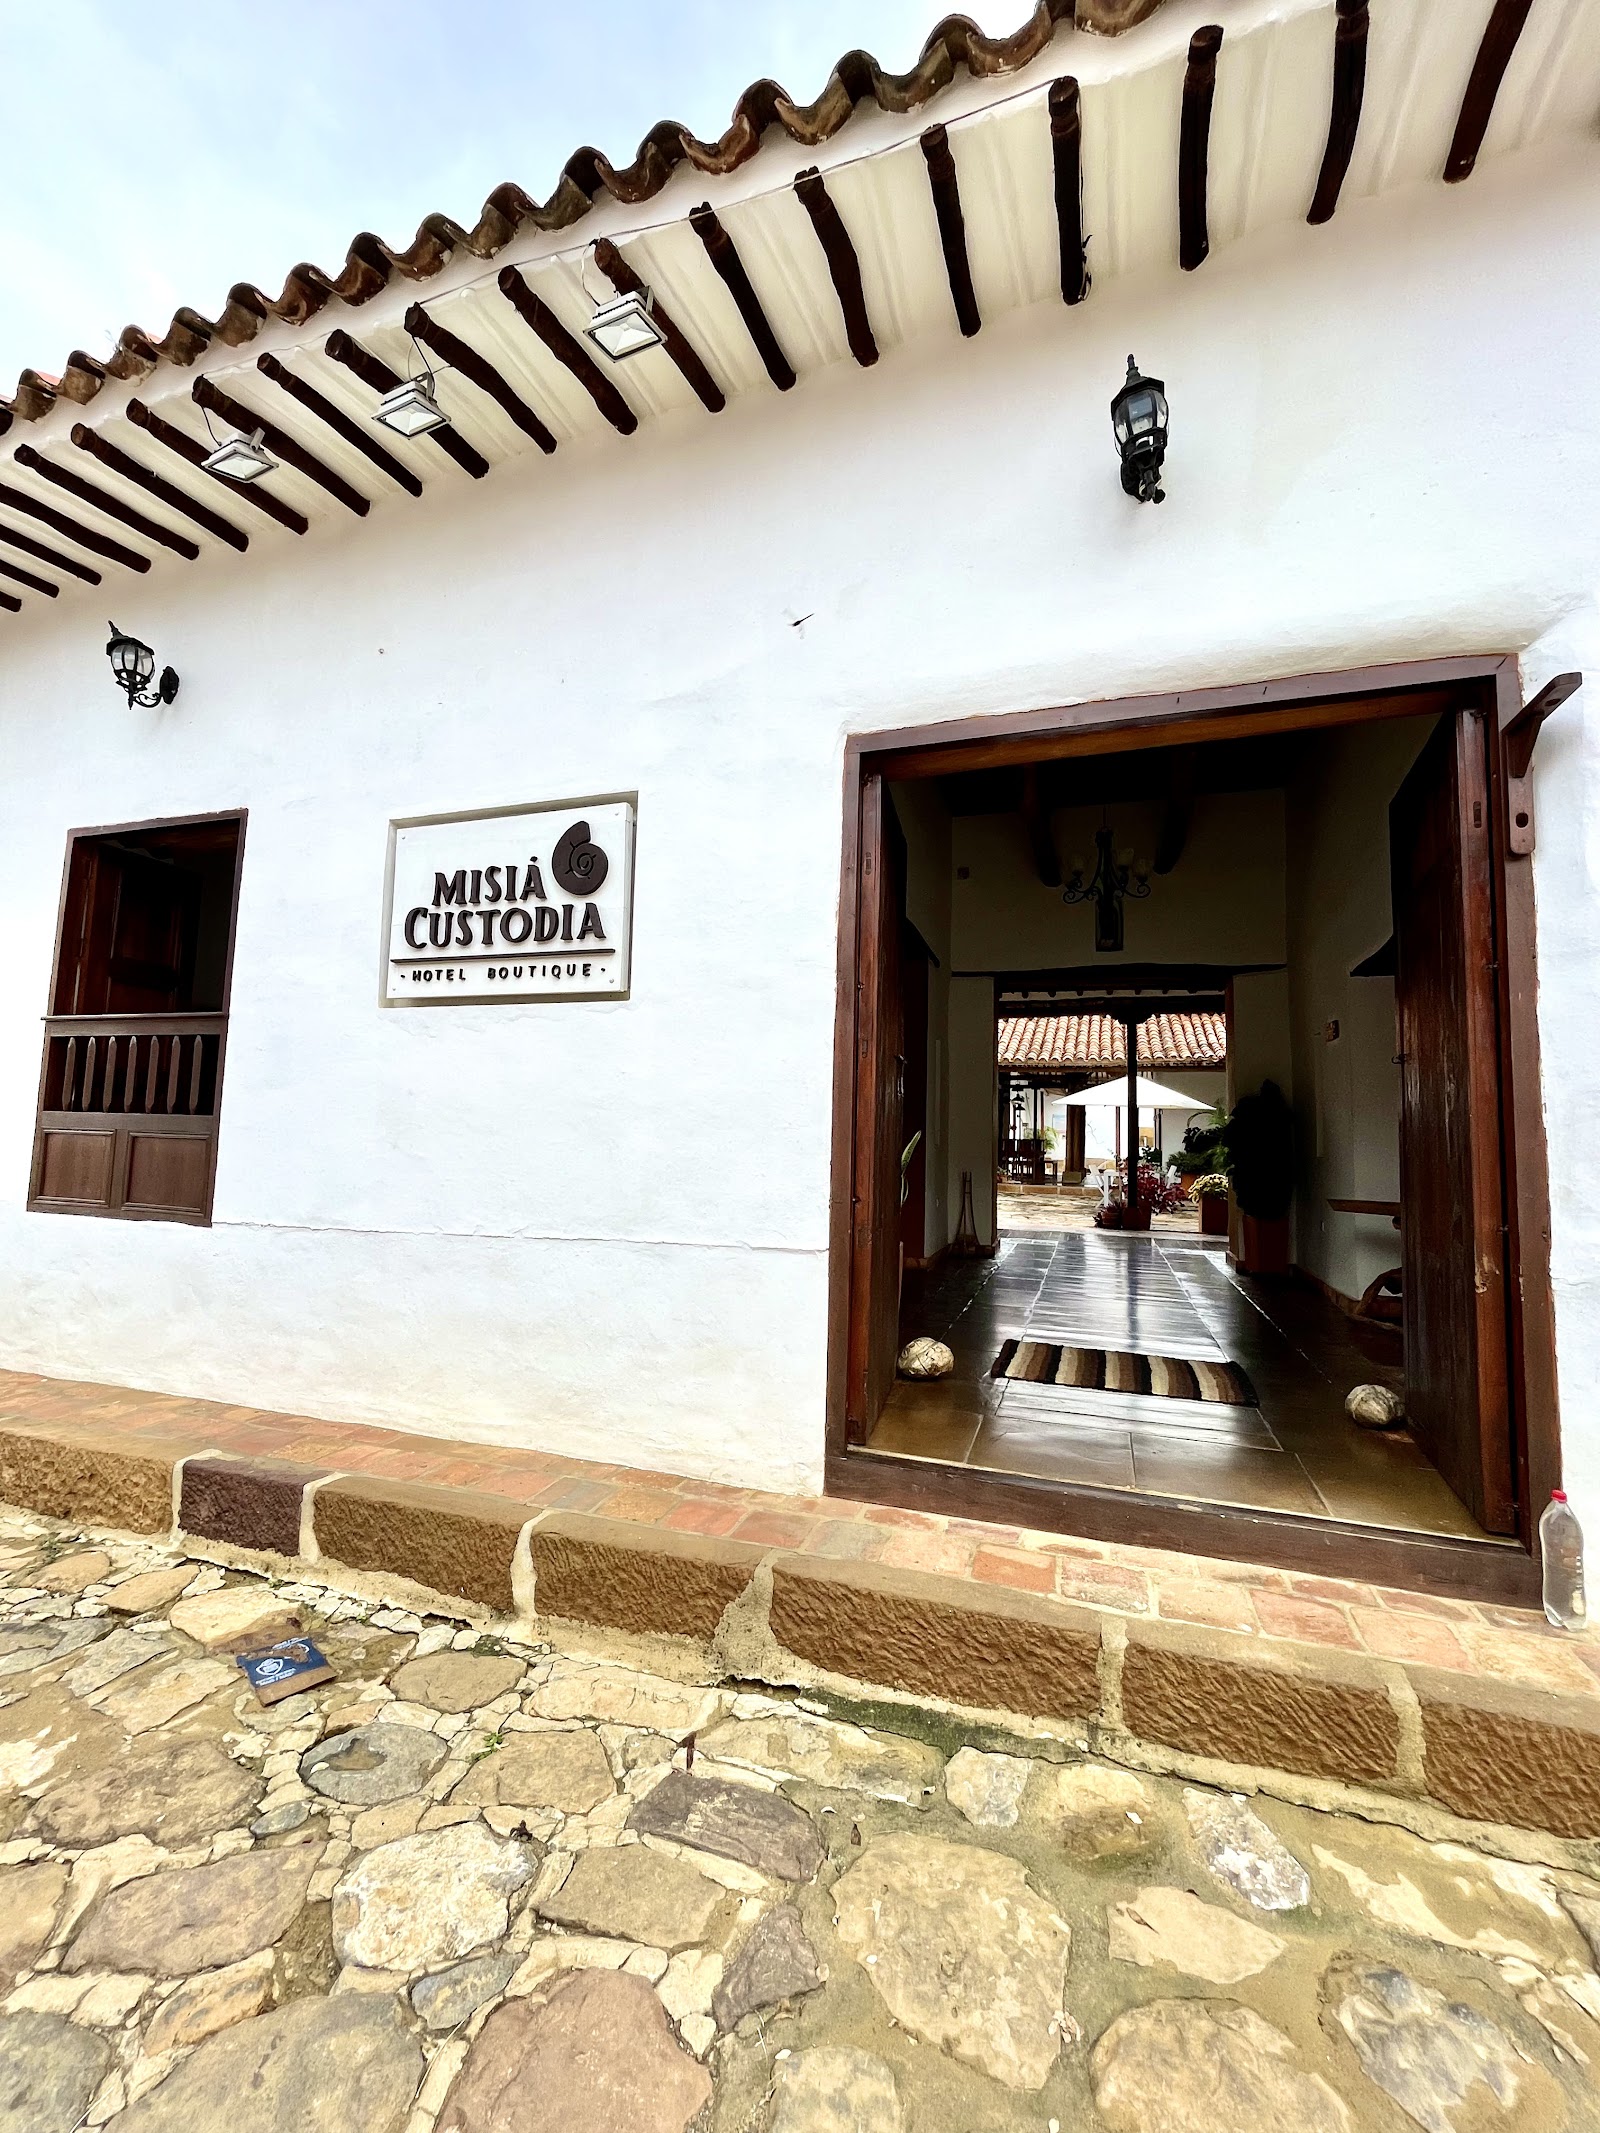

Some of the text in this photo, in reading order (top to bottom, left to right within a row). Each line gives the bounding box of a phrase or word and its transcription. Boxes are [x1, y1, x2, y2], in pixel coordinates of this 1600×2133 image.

[404, 903, 607, 949] CUSTODIA
[412, 963, 592, 982] HOTEL BOUTIQUE
